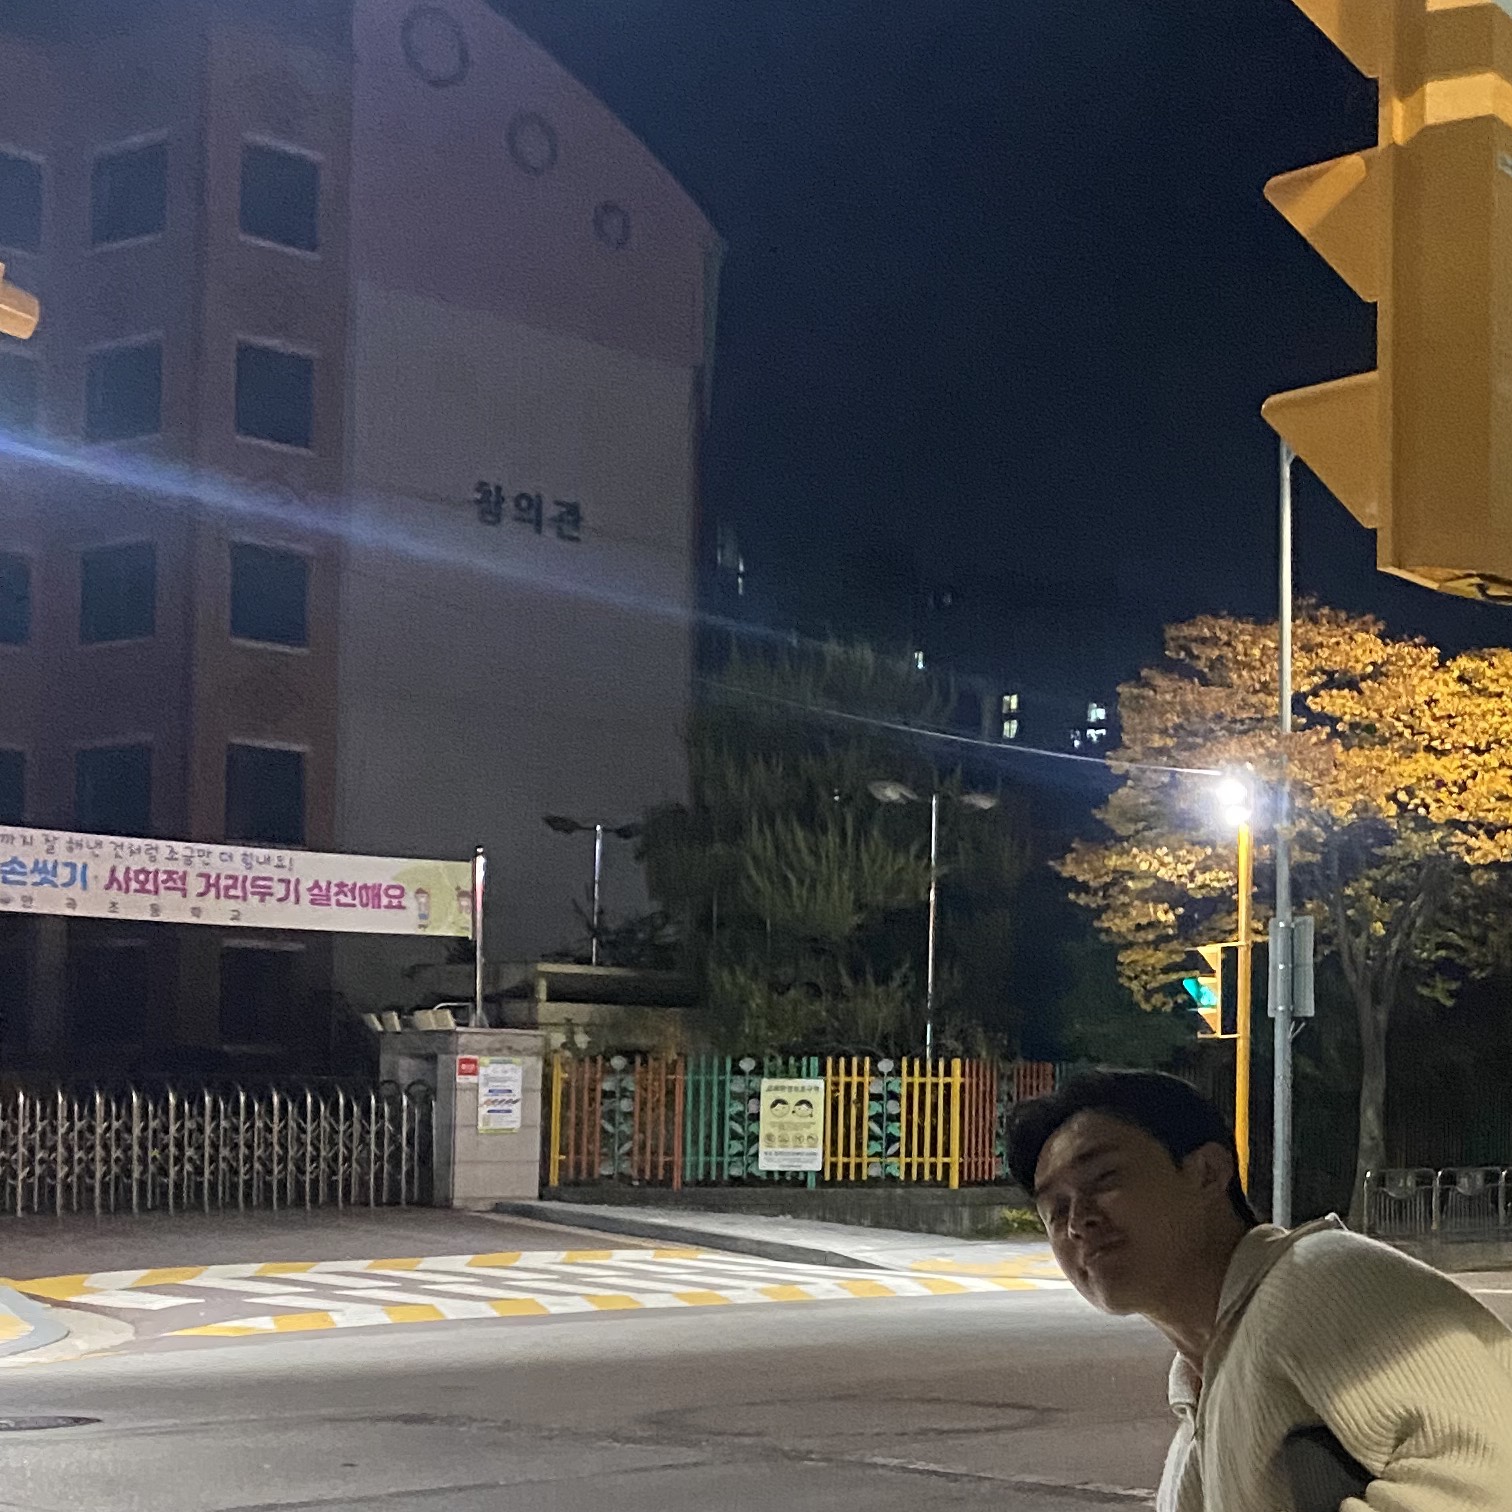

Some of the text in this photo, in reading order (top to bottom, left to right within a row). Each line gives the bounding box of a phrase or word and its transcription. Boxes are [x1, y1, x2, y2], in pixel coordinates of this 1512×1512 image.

[473, 480, 583, 542] 창의관
[42, 833, 59, 855] 잘
[109, 840, 159, 863] 것처럼
[165, 845, 213, 866] 조금만
[219, 851, 233, 862] 더
[0, 855, 407, 910] 손씻기 사회적 거리두기 실천해요
